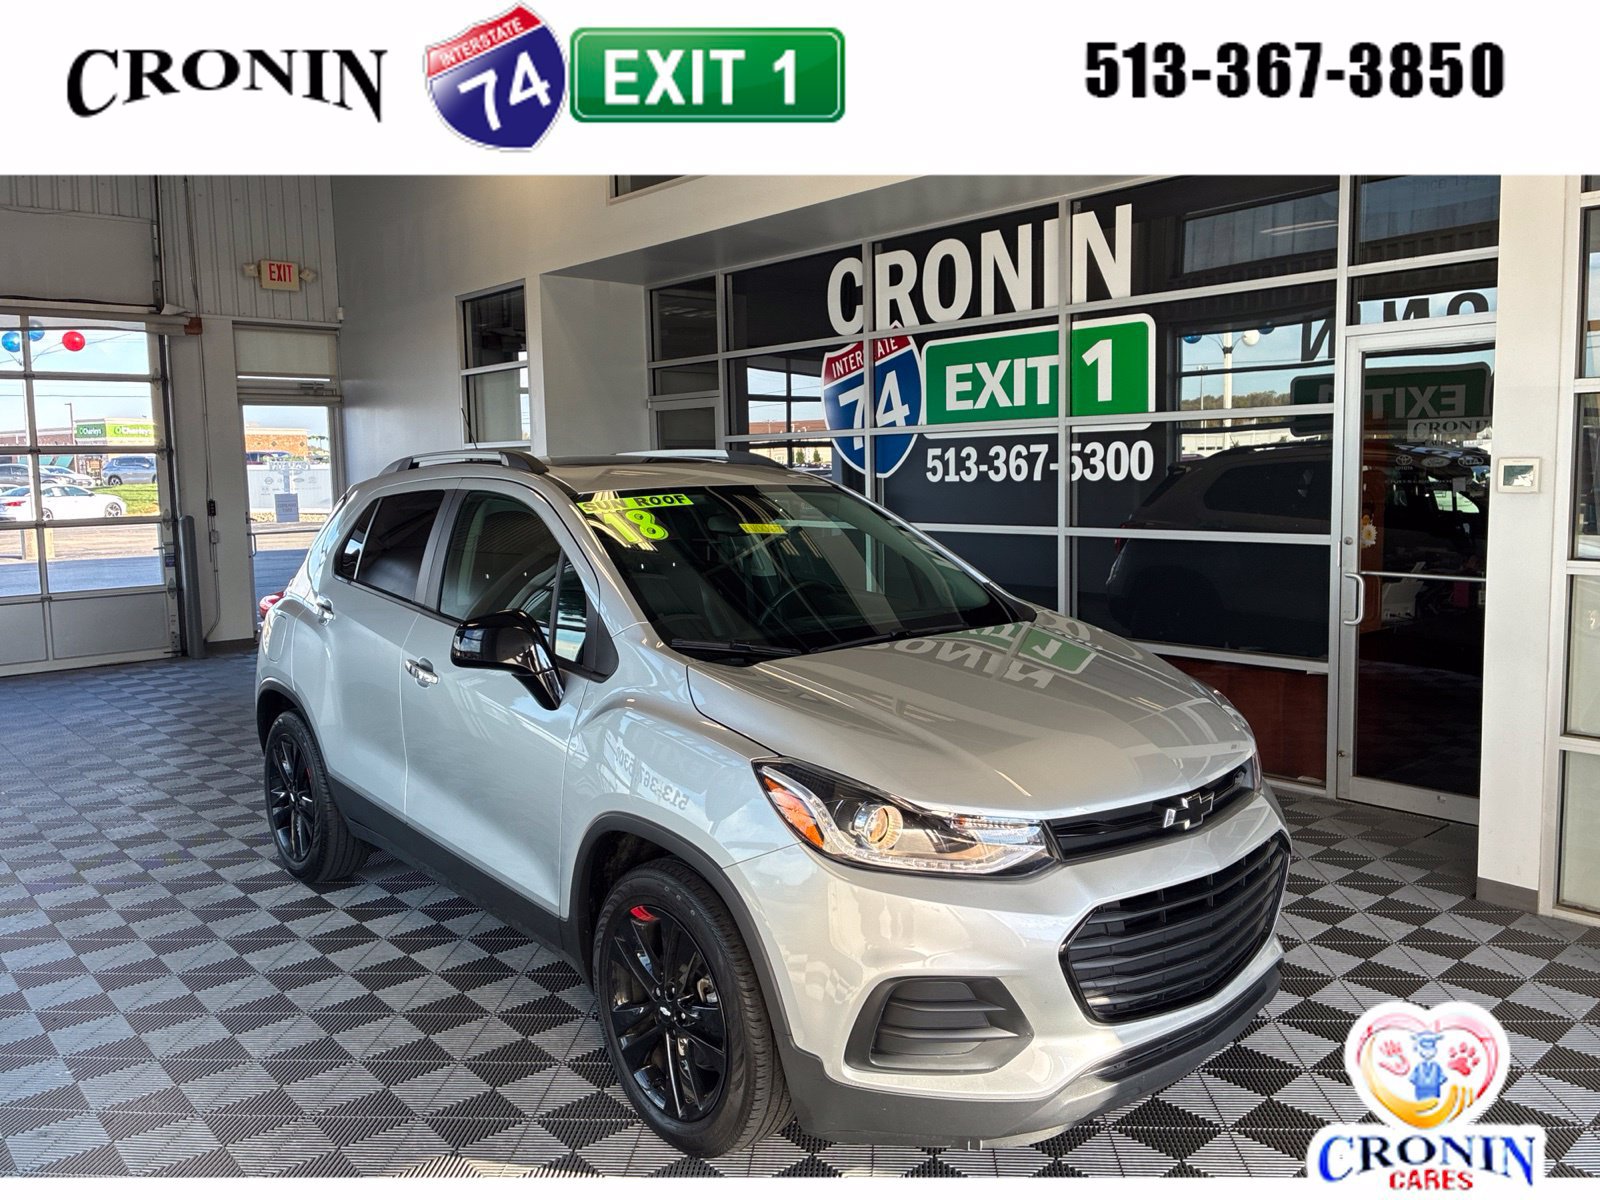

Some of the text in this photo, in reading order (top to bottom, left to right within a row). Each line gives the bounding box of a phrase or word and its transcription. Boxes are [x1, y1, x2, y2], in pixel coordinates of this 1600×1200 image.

[269, 263, 293, 282] EXIT
[827, 203, 1132, 335] CRONIN
[945, 339, 1113, 411] EXIT 1
[838, 370, 910, 450] 74
[926, 439, 1154, 483] 513-367-5300
[582, 495, 687, 512] SUN ROOF
[602, 509, 669, 543] 18
